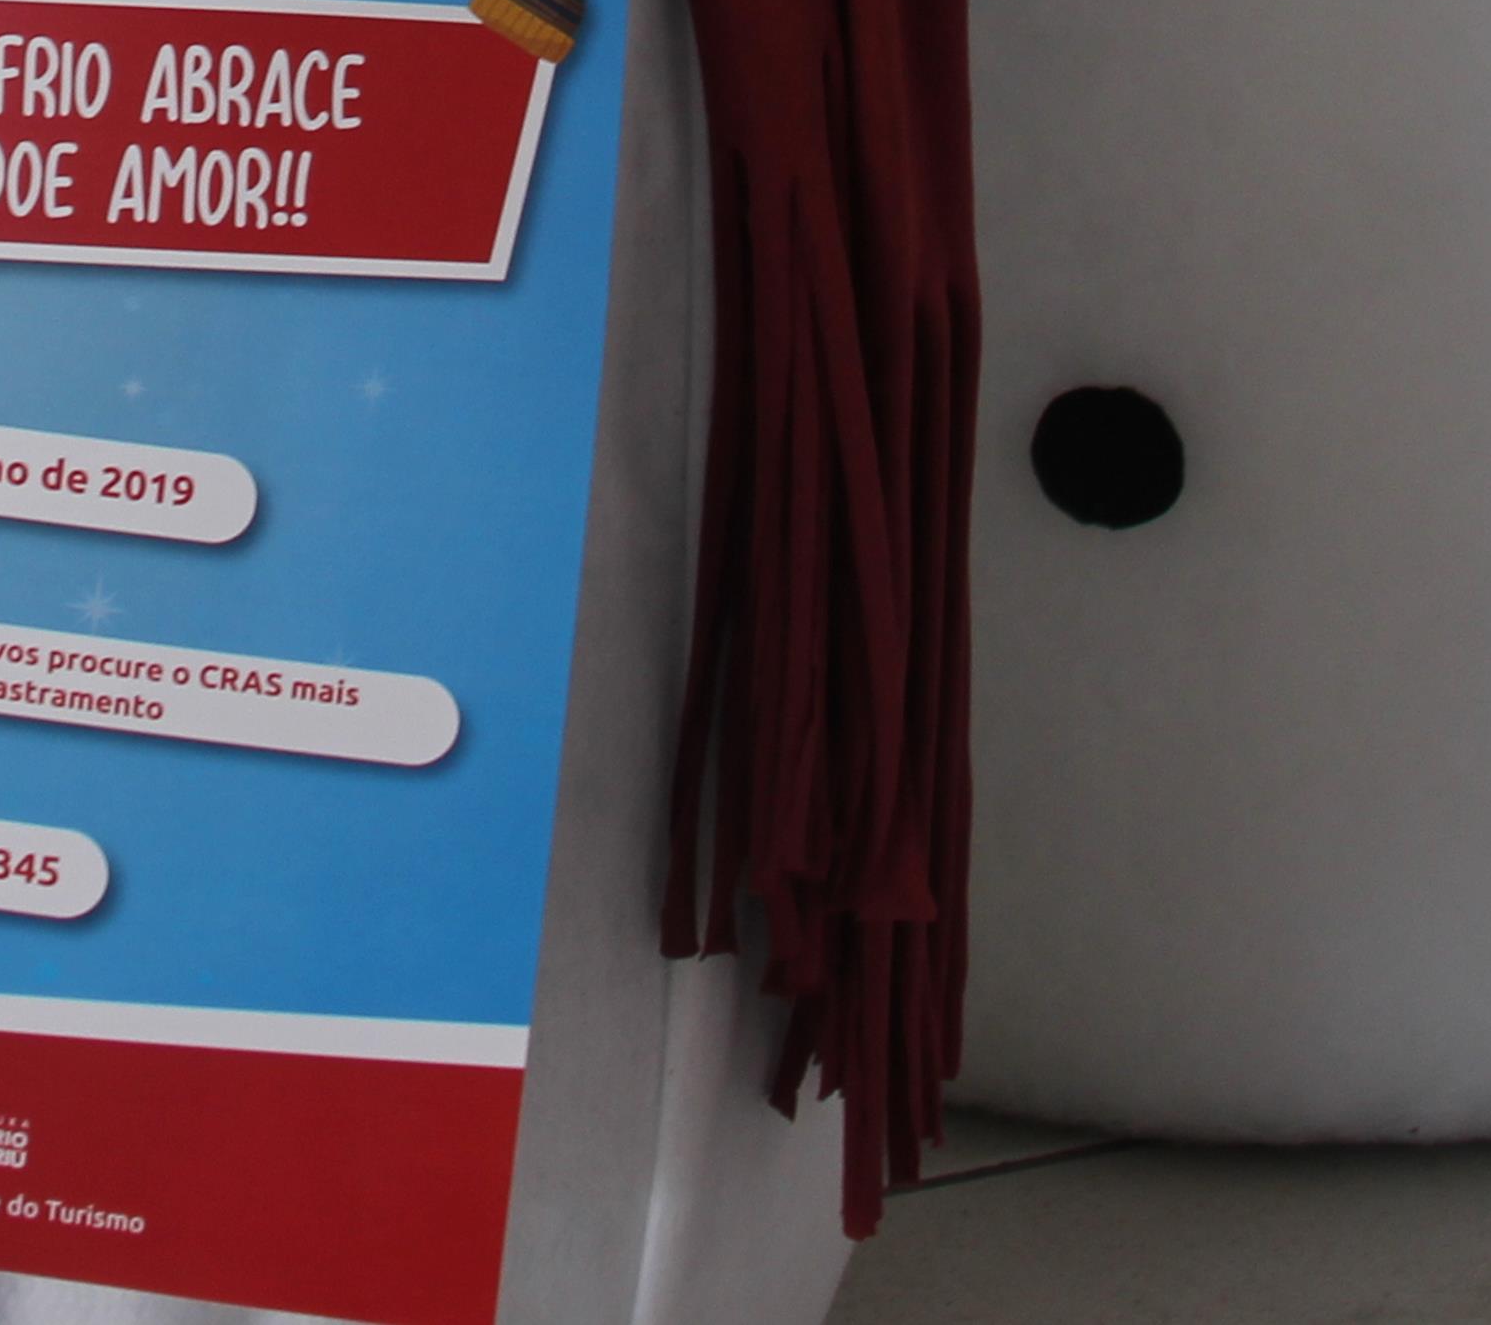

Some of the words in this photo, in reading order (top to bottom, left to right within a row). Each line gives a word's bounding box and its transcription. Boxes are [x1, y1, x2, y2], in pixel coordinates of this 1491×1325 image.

[140, 43, 365, 131] ABRACE
[106, 147, 308, 229] AMOR!!
[41, 458, 89, 494] de
[100, 466, 195, 506] 2019
[48, 650, 164, 682] procure
[172, 667, 191, 685] o
[199, 664, 283, 697] CRAS
[290, 679, 360, 707] mais
[6, 1193, 39, 1219] do
[45, 1199, 145, 1234] Turismo
